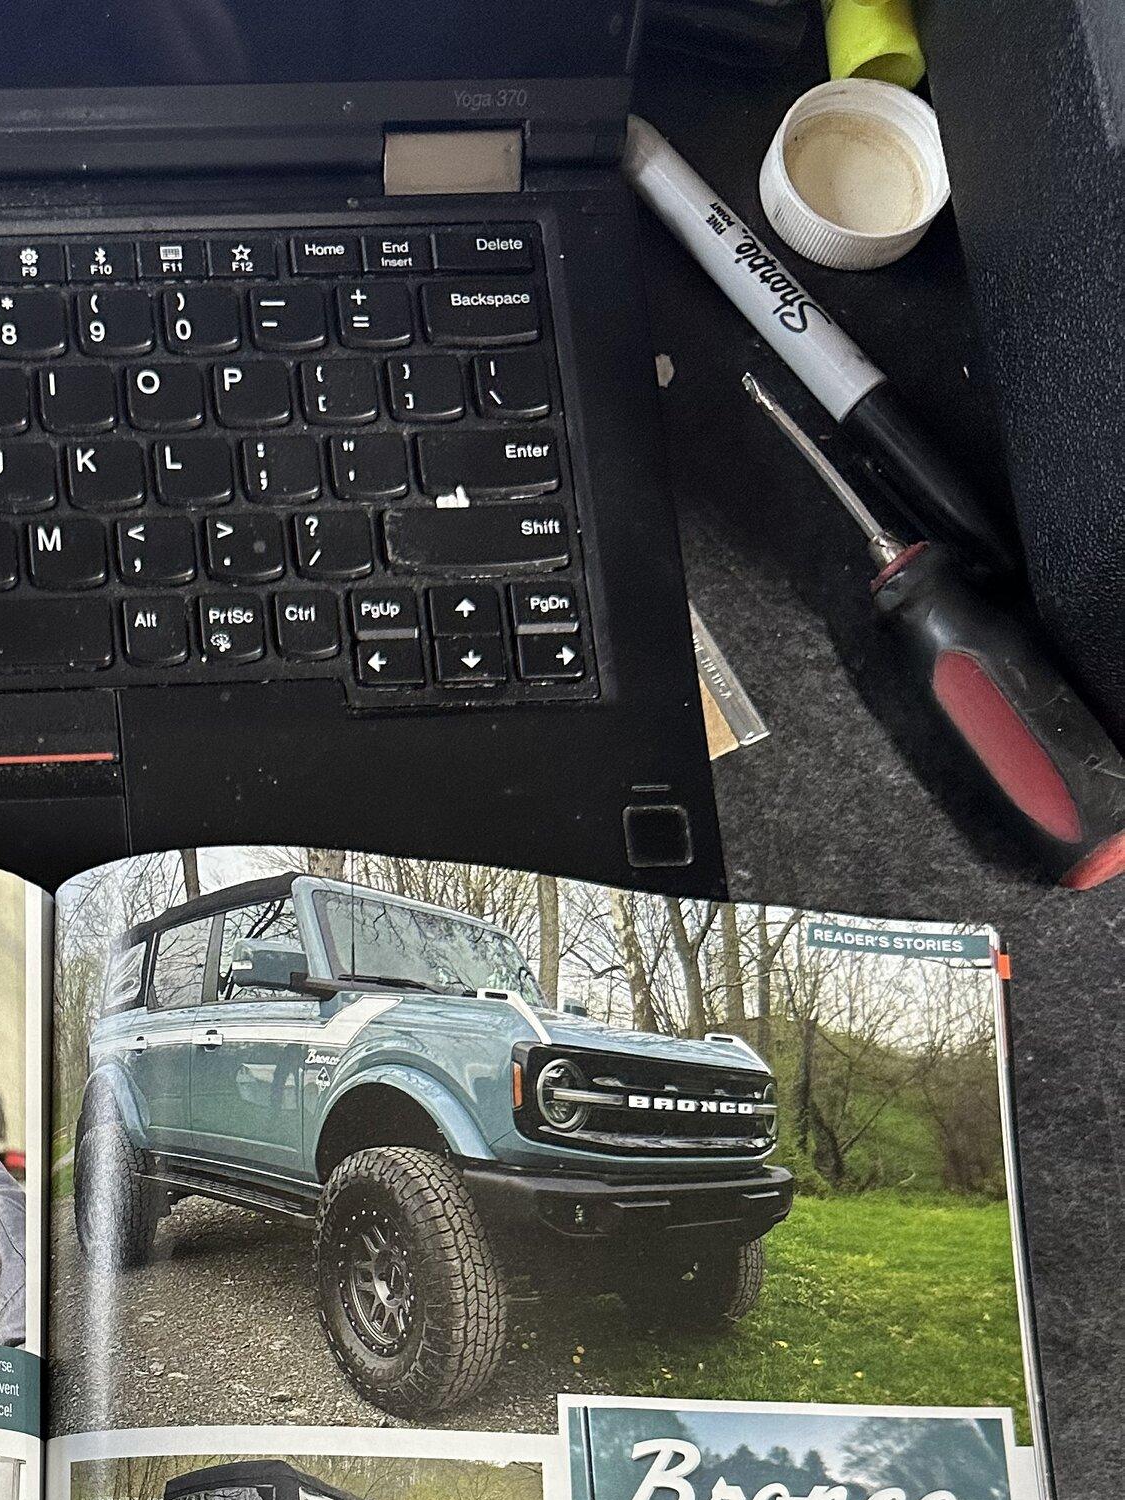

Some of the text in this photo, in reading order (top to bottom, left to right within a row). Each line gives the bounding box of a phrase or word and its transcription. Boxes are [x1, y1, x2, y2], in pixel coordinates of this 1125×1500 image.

[454, 89, 527, 110] Yoga 370
[710, 202, 735, 227] POINT
[706, 214, 726, 235] FINE
[304, 243, 345, 256] Home
[382, 241, 409, 254] End
[476, 238, 523, 251] Delete
[380, 257, 413, 267] Insert
[450, 293, 530, 308] Backspace
[505, 444, 549, 459] Enter
[521, 519, 560, 536] Shift
[360, 602, 400, 619] PgUp
[530, 596, 569, 613] PgDn
[134, 612, 157, 628] Alt
[208, 608, 254, 625] PrtSc
[284, 606, 316, 622] Ctrl
[813, 929, 964, 952] READER'S STORIES
[628, 1094, 755, 1115] BRONCO
